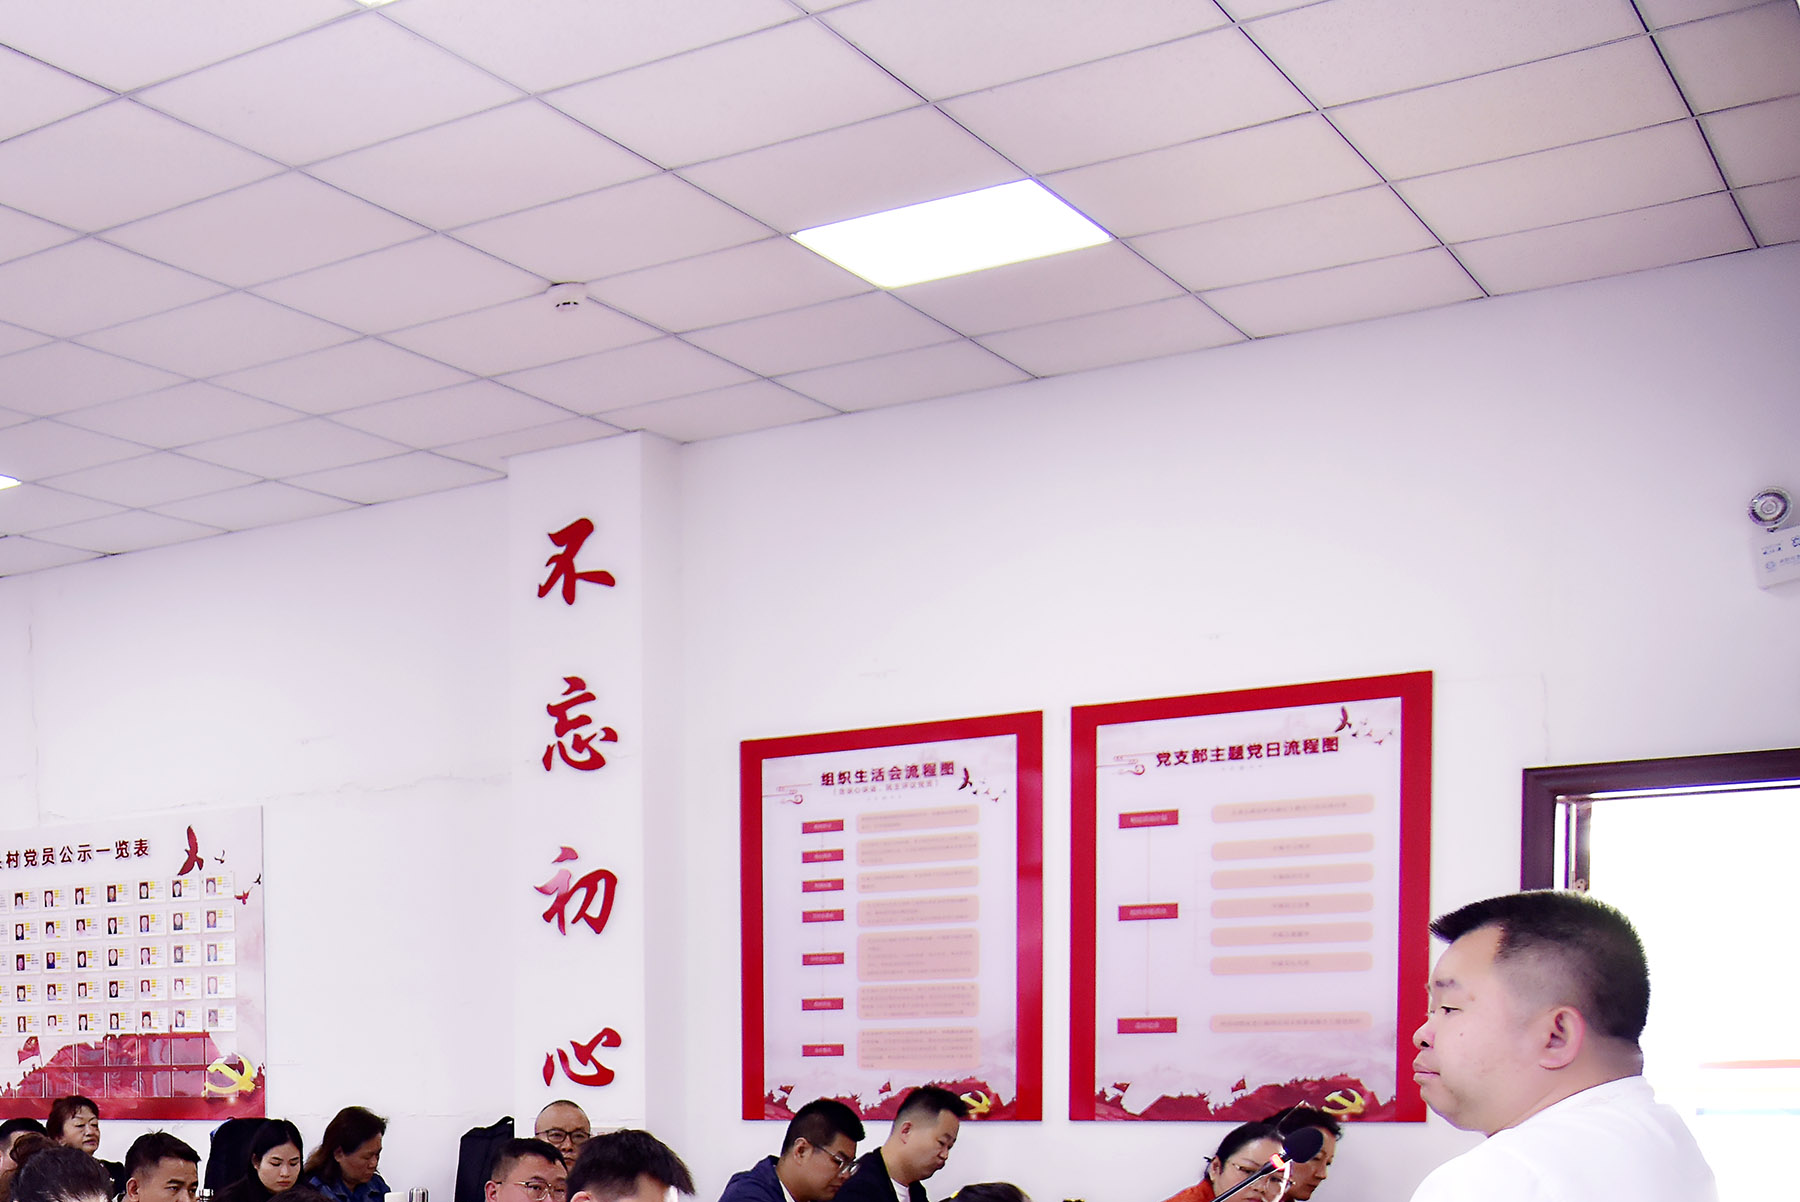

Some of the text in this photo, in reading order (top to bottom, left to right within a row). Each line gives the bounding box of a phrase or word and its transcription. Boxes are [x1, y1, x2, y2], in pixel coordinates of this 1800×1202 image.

[1156, 736, 1339, 768] 党支部主题党日流程图
[820, 760, 955, 786] 组织生活会流程图
[533, 517, 622, 1088] 不忘初心
